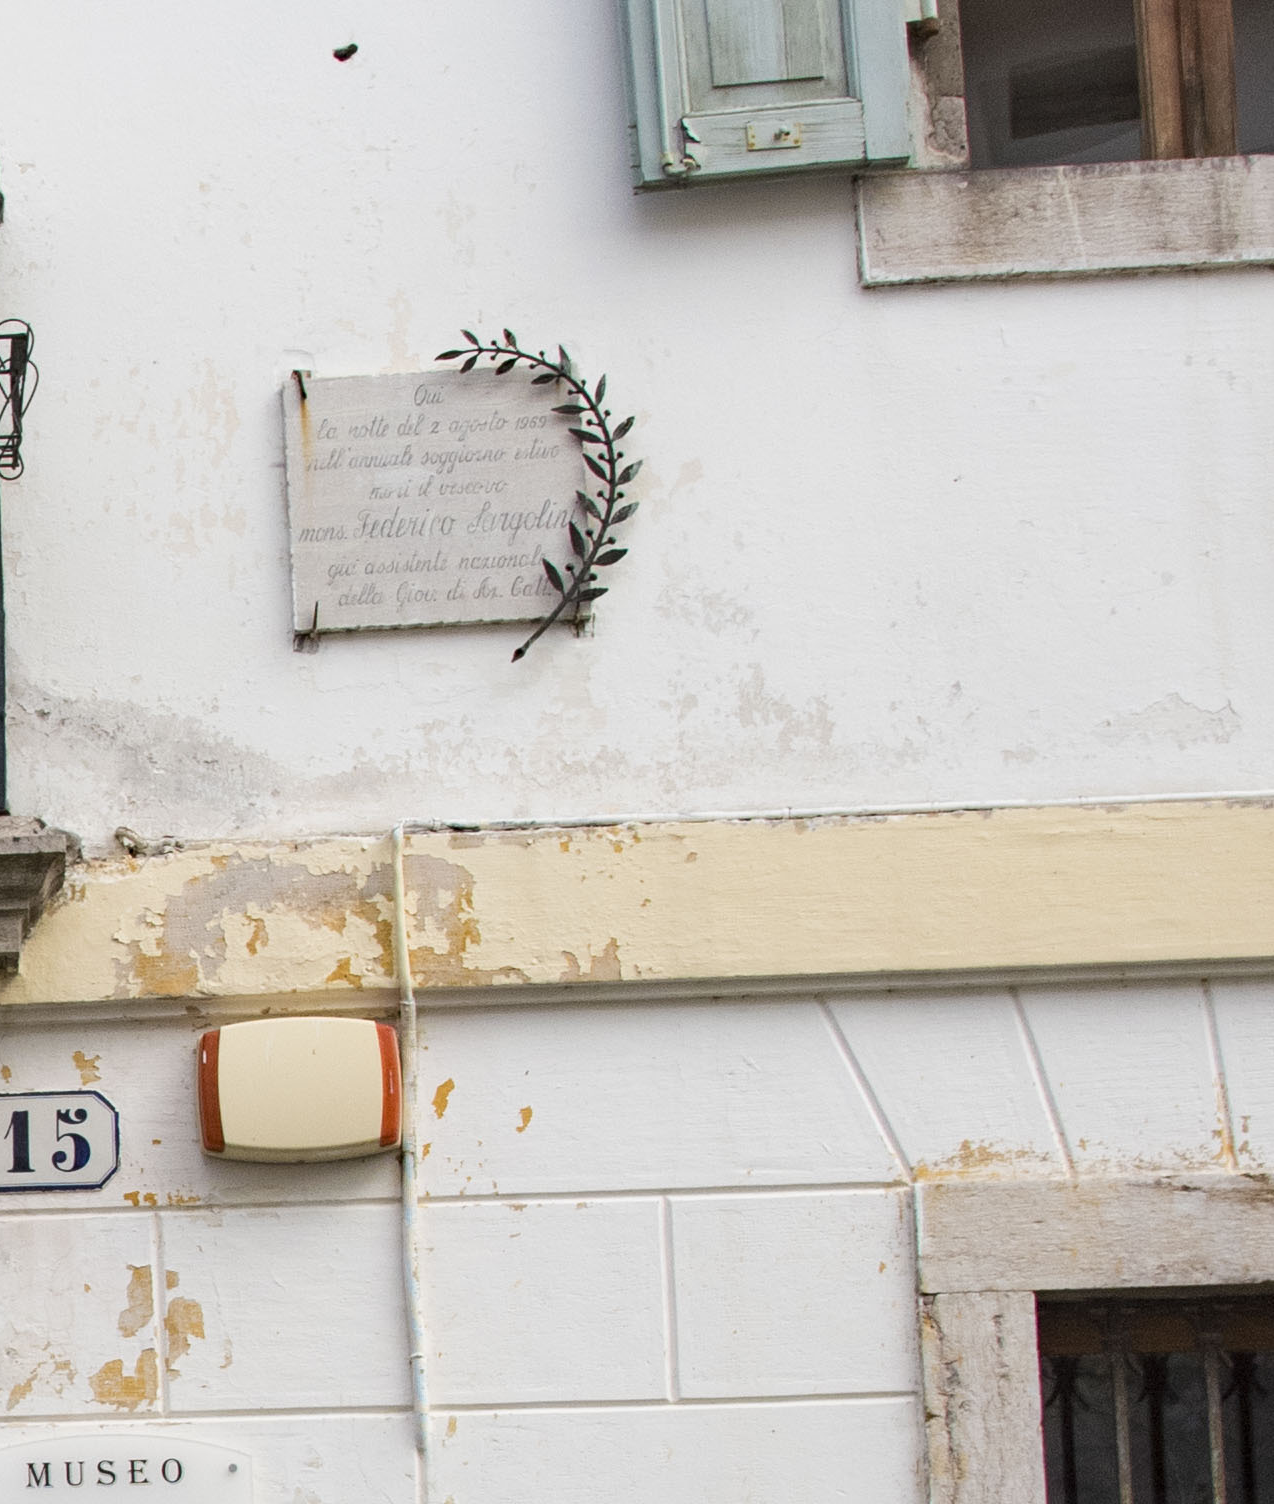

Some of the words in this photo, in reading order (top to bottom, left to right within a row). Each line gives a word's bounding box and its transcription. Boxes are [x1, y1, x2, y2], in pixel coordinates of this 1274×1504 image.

[414, 384, 444, 406] Qui
[349, 418, 388, 438] notte
[397, 415, 424, 435] del
[429, 422, 440, 434] 2
[449, 410, 507, 441] agosto
[514, 415, 547, 431] 1969
[421, 445, 505, 473] soggiorno
[514, 442, 560, 462] estivo
[419, 479, 433, 498] il
[440, 480, 508, 497] vescovo
[299, 526, 347, 543] mons.
[353, 507, 454, 544] Federico
[365, 549, 448, 574] assistente
[459, 545, 545, 572] nazionale
[338, 583, 383, 607] della
[446, 581, 465, 601] di
[4, 1108, 91, 1174] 15
[26, 1458, 185, 1489] MUSEO
